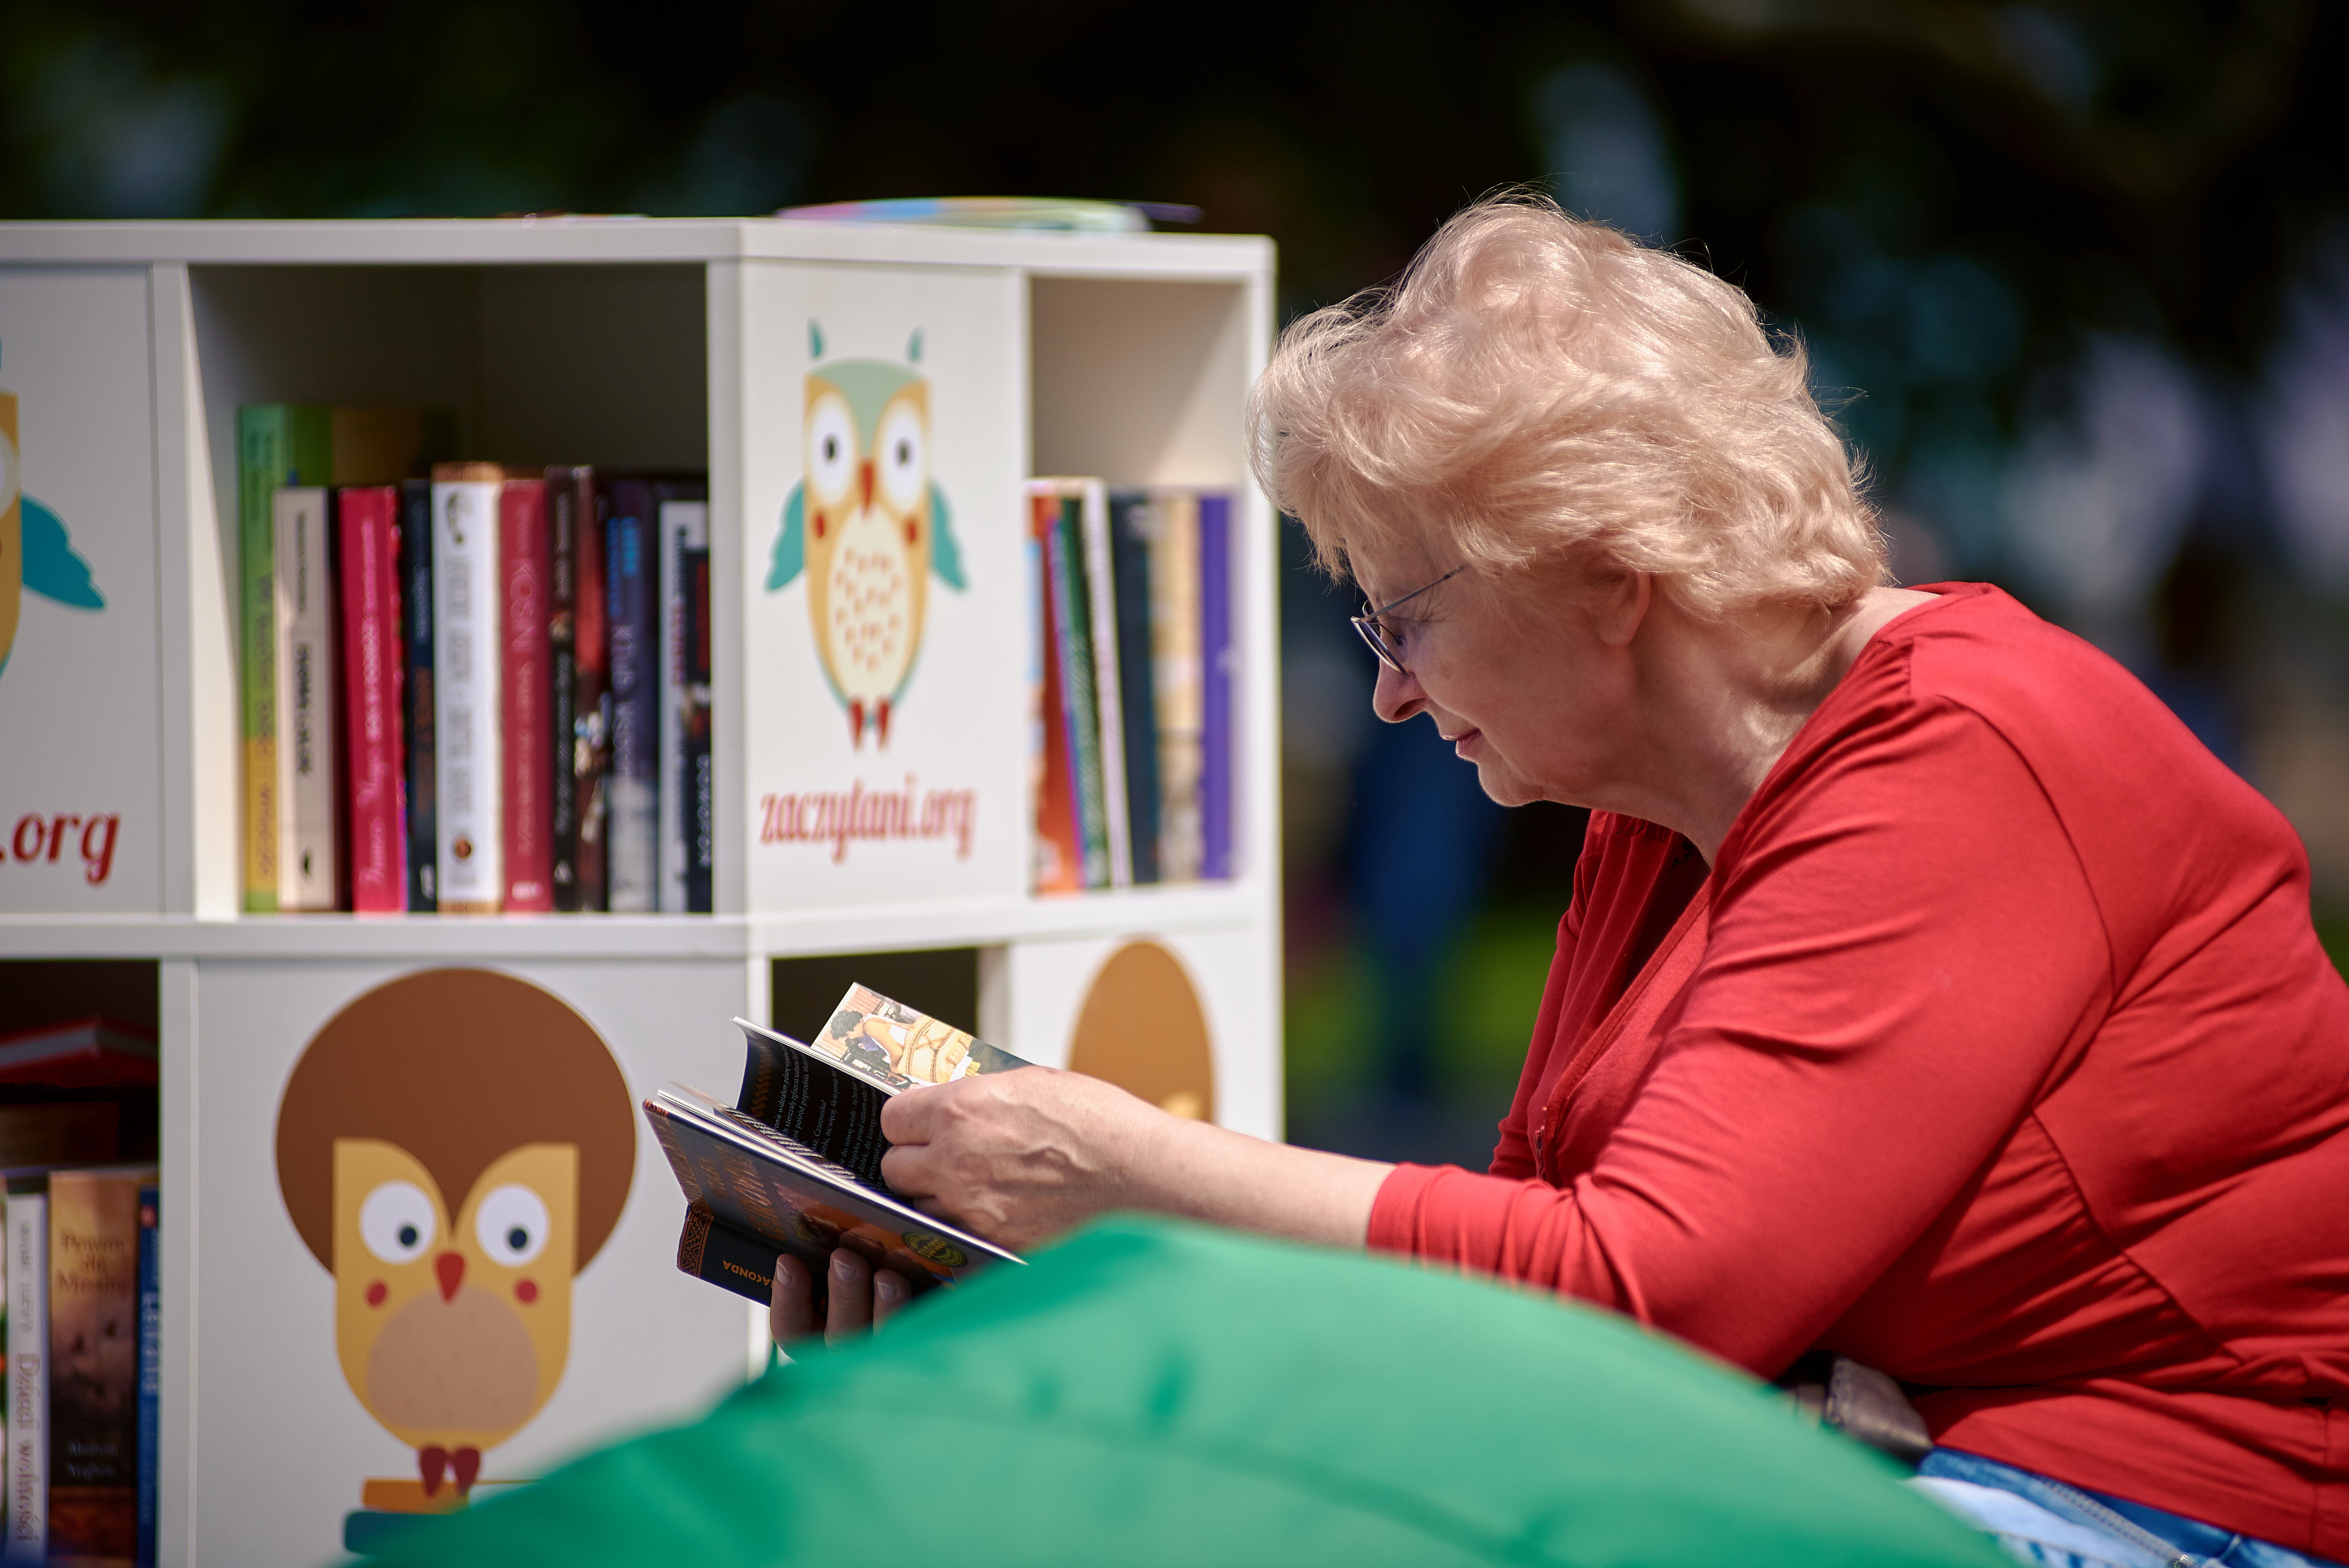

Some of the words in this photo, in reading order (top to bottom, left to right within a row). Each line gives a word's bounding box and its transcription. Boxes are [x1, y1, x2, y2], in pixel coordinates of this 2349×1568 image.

[760, 773, 976, 864] zaczytani.org
[777, 1084, 787, 1113] widziałem
[795, 1106, 804, 1129] pośród
[813, 1099, 827, 1136] Czarowniku?
[848, 1109, 856, 1127] wioski
[864, 1117, 877, 1140] którego
[844, 1128, 854, 1146] nowej
[848, 1142, 860, 1168] klepisku
[854, 1124, 864, 1141] przed
[864, 1140, 871, 1149] do
[840, 1148, 848, 1157] do
[858, 1152, 869, 1172] dołek,
[868, 1148, 880, 1179] przysypał
